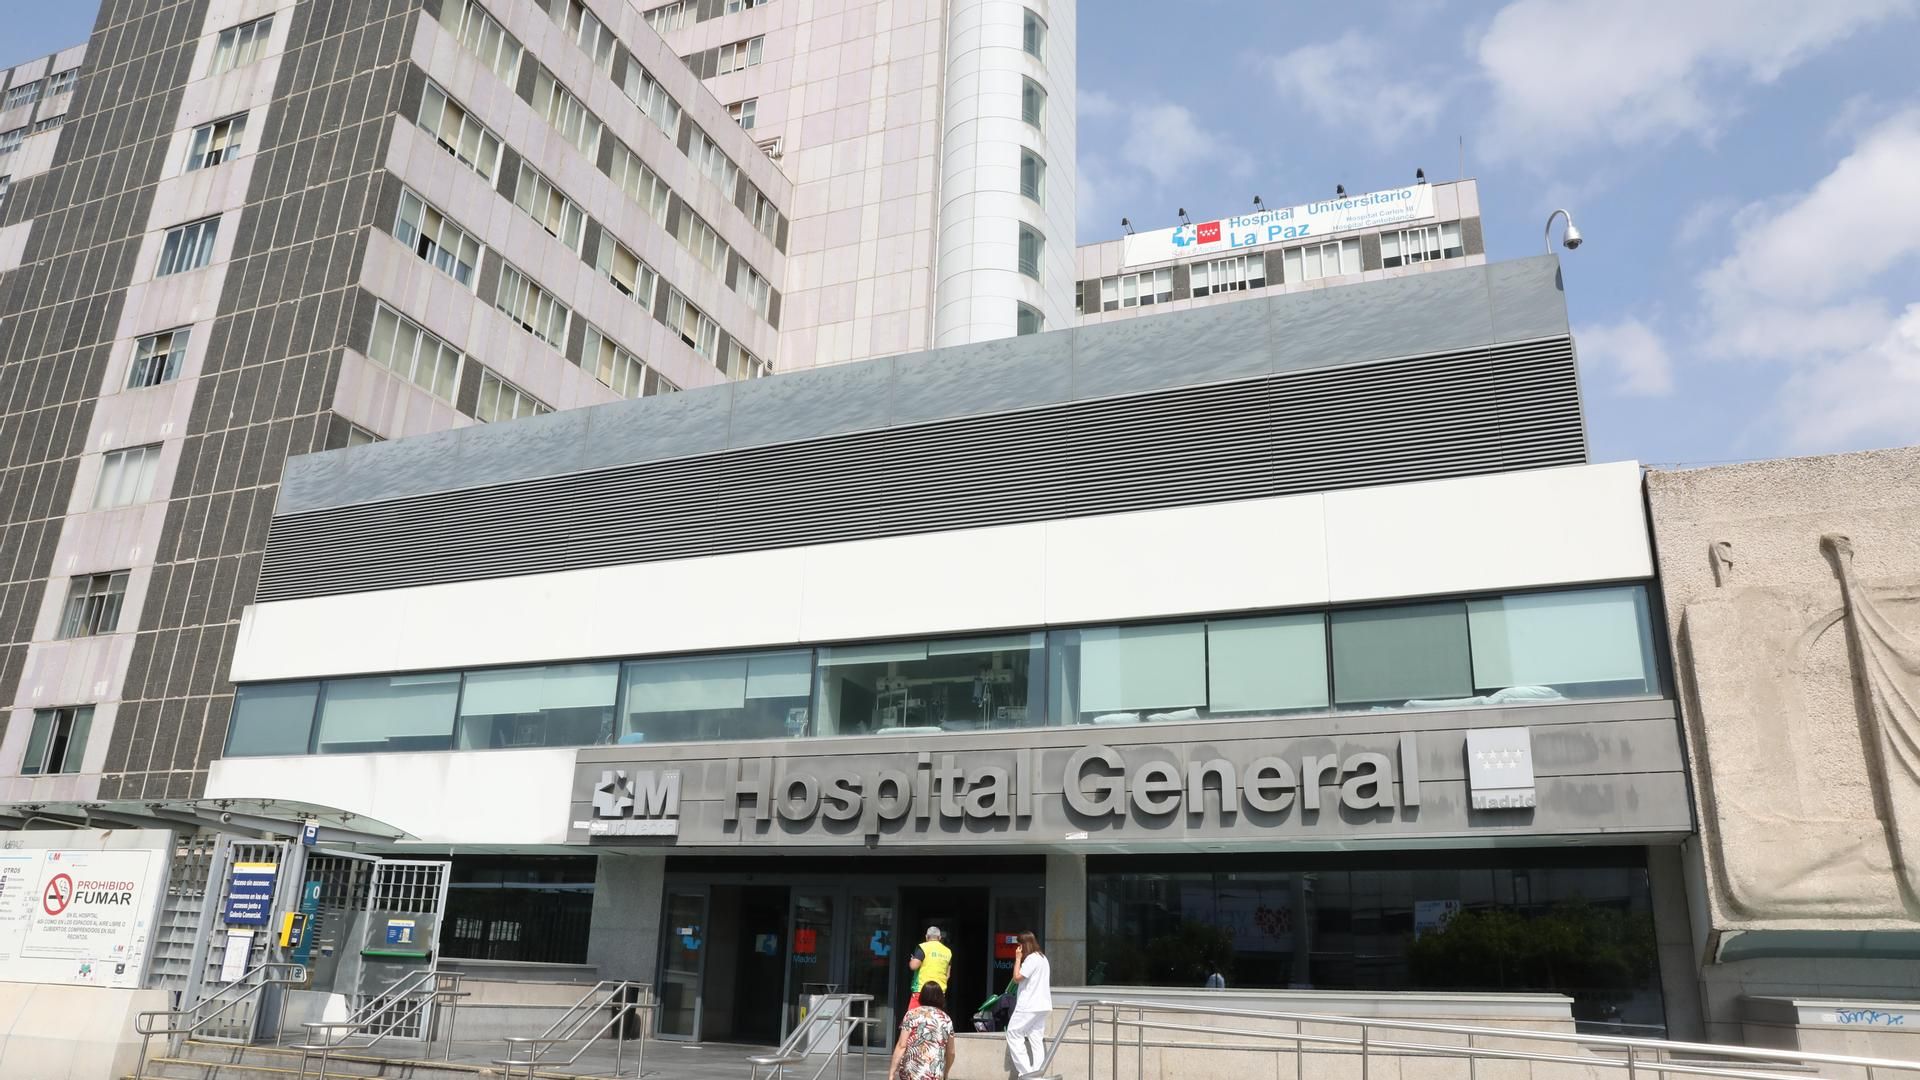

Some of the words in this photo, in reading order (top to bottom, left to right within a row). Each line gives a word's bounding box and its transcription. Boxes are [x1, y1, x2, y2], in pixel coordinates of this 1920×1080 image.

[1229, 207, 1294, 228] Hospital
[1308, 190, 1412, 215] Universitario
[1346, 212, 1378, 222] Hospital
[1379, 207, 1404, 217] Carlos
[1332, 221, 1364, 231] Hospital
[1231, 233, 1257, 247] La
[1268, 224, 1310, 241] Paz
[724, 748, 1033, 838] Hospital
[1063, 731, 1420, 818] General
[1472, 794, 1536, 809] Madrid
[77, 880, 134, 891] PROHIBIDO
[74, 891, 132, 905] FUMAR
[793, 954, 817, 963] Madrid
[993, 960, 1014, 969] Madr
